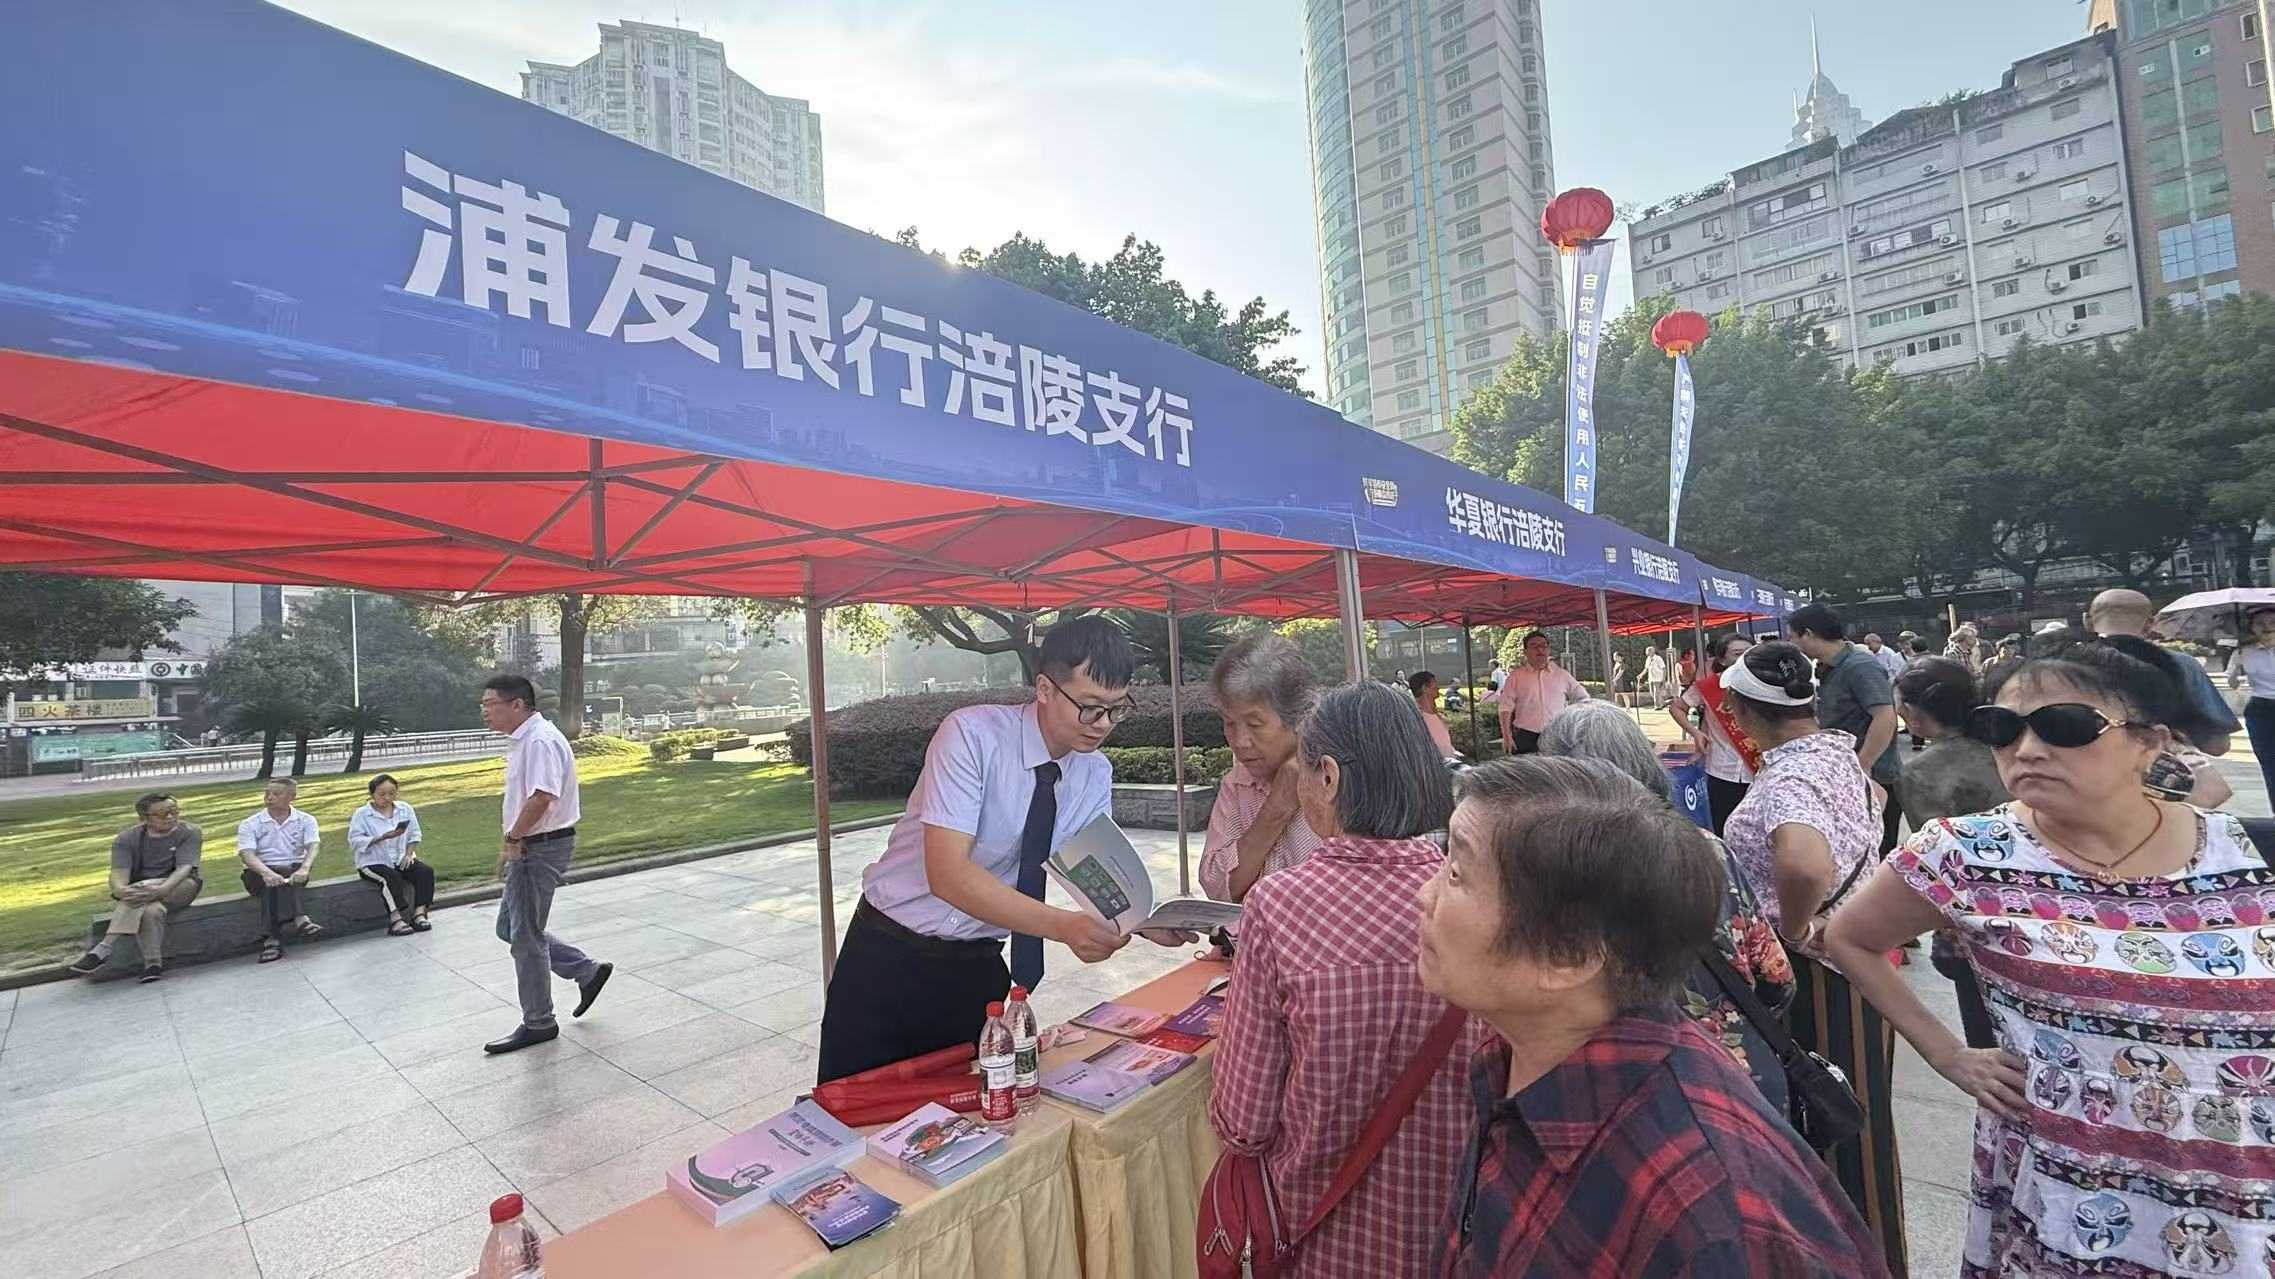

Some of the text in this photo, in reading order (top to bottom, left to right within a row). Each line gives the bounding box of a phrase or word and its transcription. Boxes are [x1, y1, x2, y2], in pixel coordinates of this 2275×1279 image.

[402, 149, 1193, 468] 浦发银行涪陵支行
[1446, 487, 1566, 557] 华夏银行涪陵支行
[1631, 547, 1680, 585] 兴业银行涪陵支行
